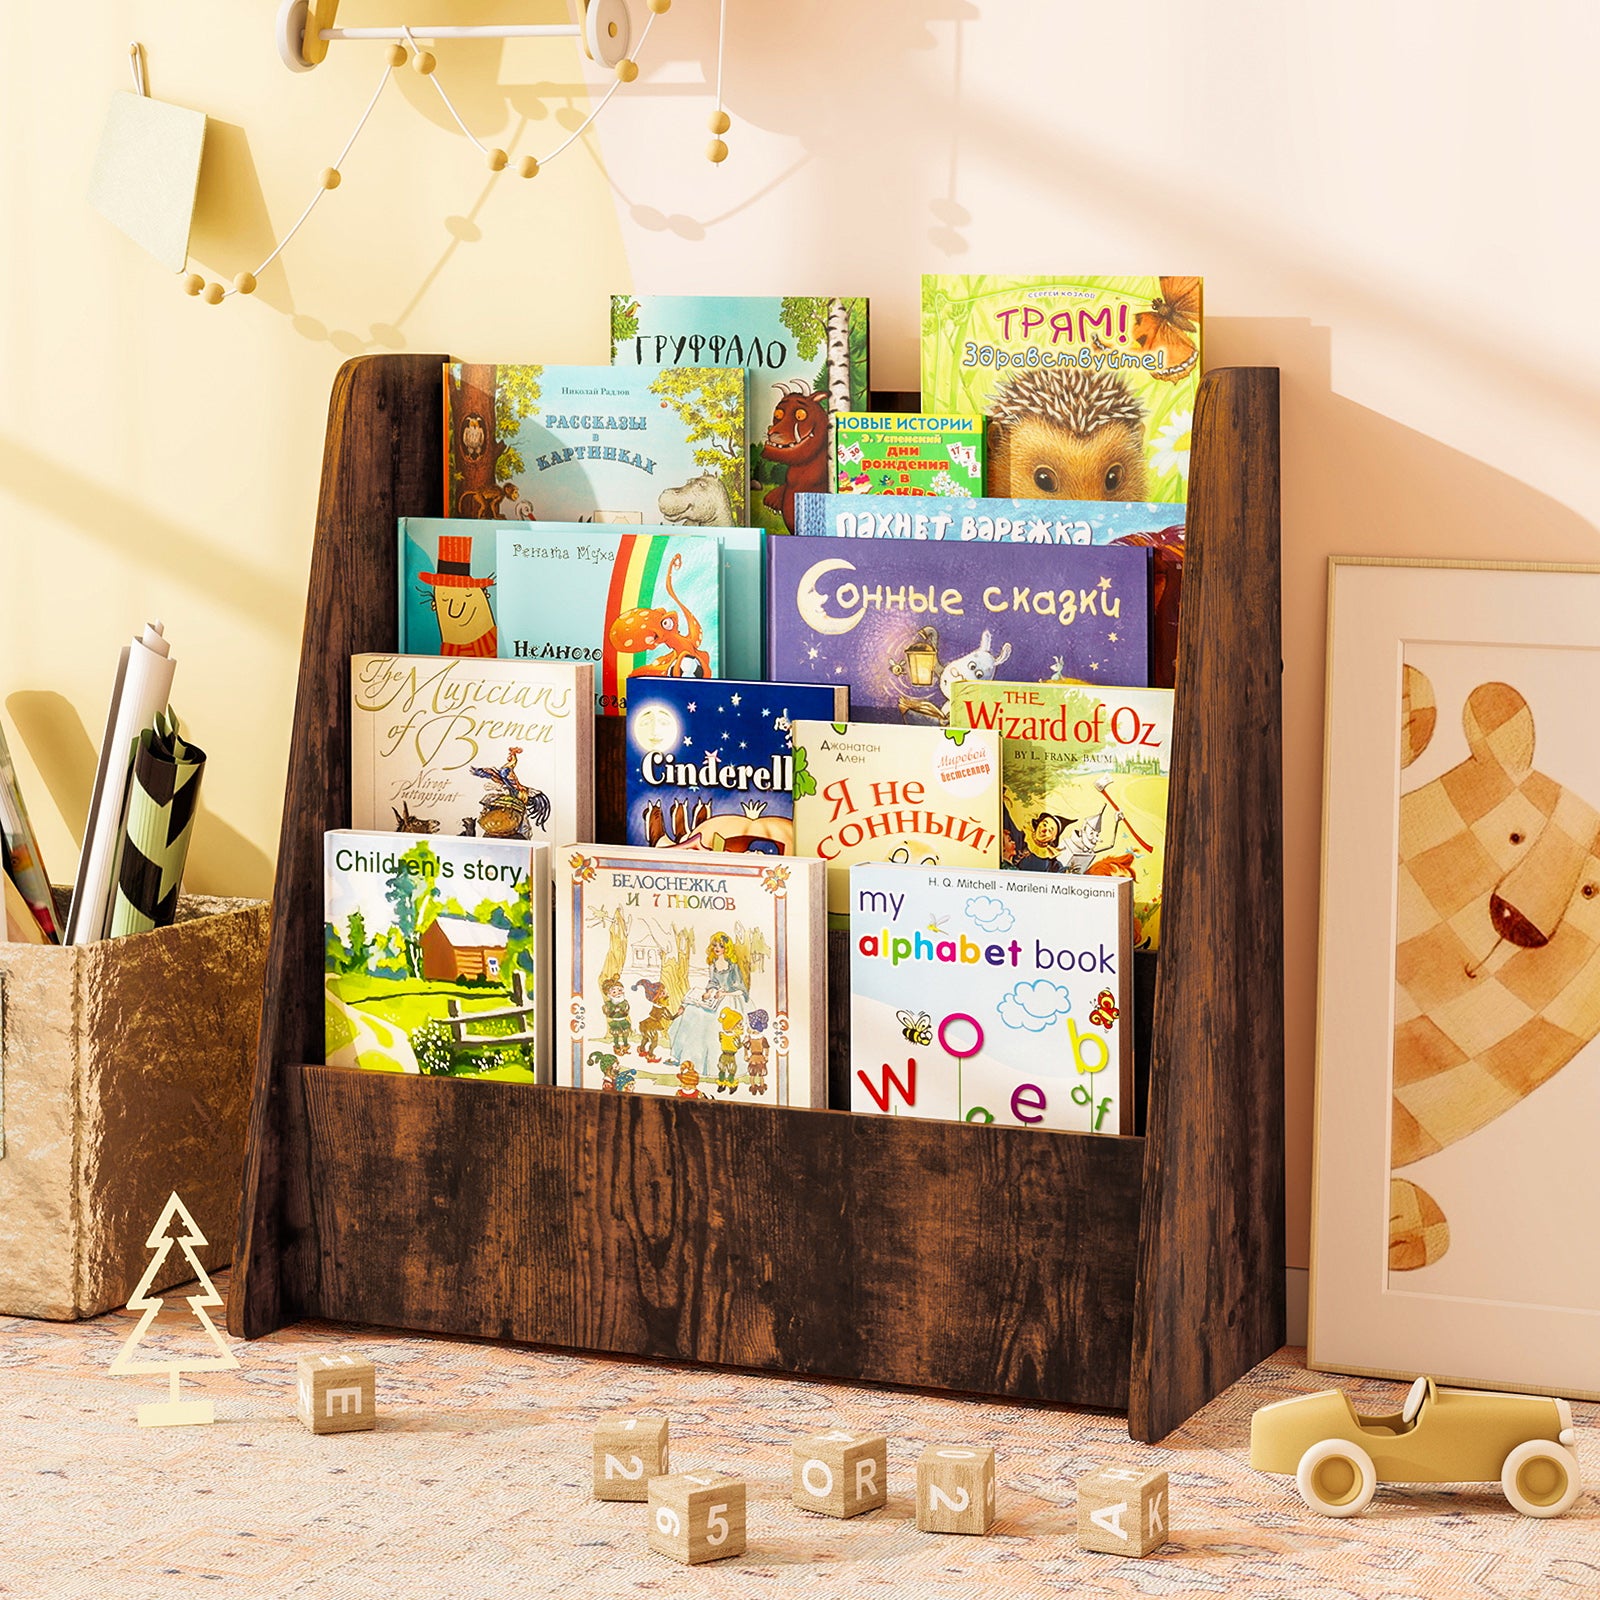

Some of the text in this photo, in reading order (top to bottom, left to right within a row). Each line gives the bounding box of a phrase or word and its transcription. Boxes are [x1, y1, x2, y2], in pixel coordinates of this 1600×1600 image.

[996, 304, 1128, 345] ТРЯМ!
[635, 334, 787, 369] ГРУФФАЛО
[963, 342, 1164, 371] Здравствуйте!
[561, 386, 630, 396] Николай Радлов
[545, 414, 648, 431] РАССКАЗЫ
[837, 416, 973, 432] НОВЫЕ ИСТОРИИ
[875, 433, 943, 445] Успенский
[535, 445, 658, 476] КАРТИНКАХ
[861, 459, 950, 472] рождения
[512, 543, 615, 565] Рената Муха
[983, 576, 1121, 627] сказки
[354, 660, 572, 719] Musicians
[358, 656, 404, 699] The
[1003, 690, 1046, 706] THE
[379, 705, 554, 771] of Bremen
[963, 700, 1163, 748] Wizard of Oz
[820, 739, 881, 753] Джонатан
[835, 752, 866, 764] Ален
[937, 746, 986, 770] Мировой
[1014, 750, 1113, 764] BY L. FRANK BAUM
[822, 777, 925, 824] Я не
[816, 809, 996, 862] сонный!
[335, 849, 523, 889] Children's story
[612, 873, 728, 894] БЕЛОСНЕЖКА
[625, 892, 737, 911] И 7 ГНОМОВ
[928, 877, 939, 887] H.
[942, 878, 955, 888] Q.
[957, 878, 997, 891] Mitchell
[1006, 883, 1049, 895] Marileni
[1051, 885, 1116, 900] Malkogianni
[859, 890, 905, 922] my
[858, 928, 1117, 975] alphabet book
[1067, 1017, 1110, 1075] b
[1010, 1083, 1047, 1123] e
[1096, 1097, 1113, 1130] f
[326, 1386, 362, 1417] E
[605, 1453, 644, 1480] 2
[855, 1458, 878, 1499] R
[929, 1483, 970, 1512] 2
[706, 1503, 729, 1546] 5
[1090, 1502, 1128, 1541] A
[1149, 1491, 1164, 1539] K
